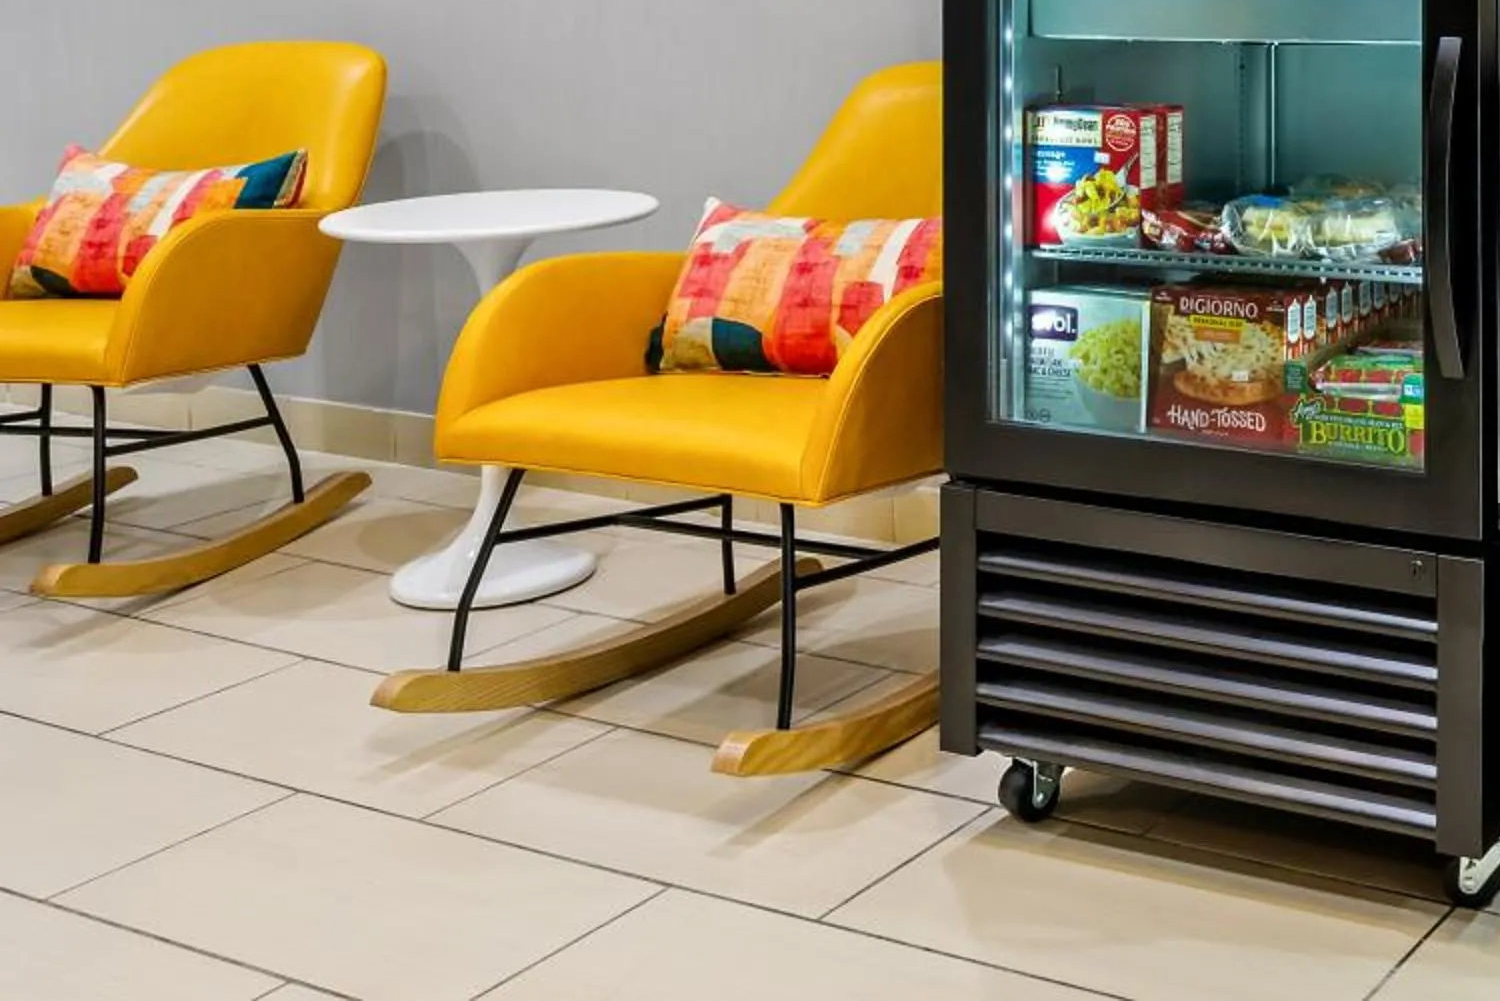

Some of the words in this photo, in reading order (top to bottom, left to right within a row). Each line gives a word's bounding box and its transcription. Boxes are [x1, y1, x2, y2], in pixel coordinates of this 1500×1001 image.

[1179, 296, 1259, 319] DIGIORNO
[1167, 403, 1266, 433] HAND-TOSSED
[1309, 420, 1405, 455] BURRITO
